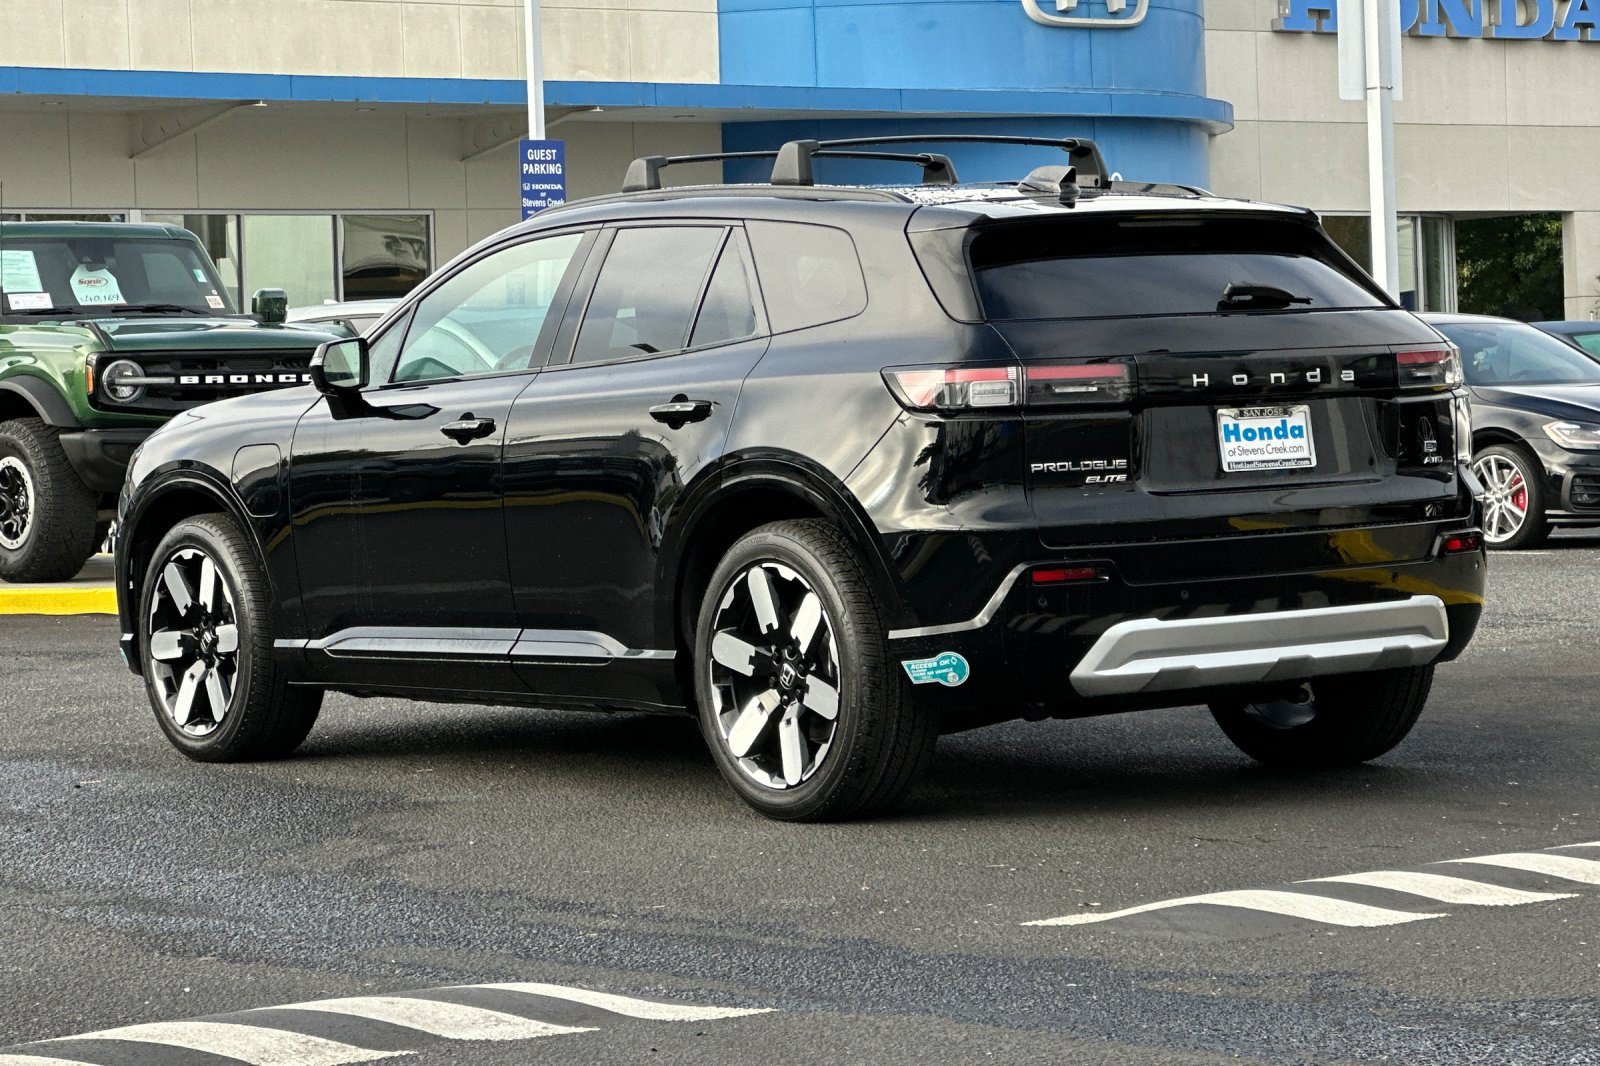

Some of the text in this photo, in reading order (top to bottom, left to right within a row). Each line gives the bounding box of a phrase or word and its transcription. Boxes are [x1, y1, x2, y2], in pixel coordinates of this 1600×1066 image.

[1273, 0, 1600, 41] HNDA
[528, 149, 556, 160] GUEST
[523, 163, 562, 174] PARKING
[522, 198, 547, 207] Stevens
[78, 277, 103, 285] Sonic
[1192, 368, 1355, 387] Honda
[1243, 408, 1284, 417] SAN JOSE
[1223, 419, 1304, 443] Honda
[1228, 442, 1304, 457] of Stevens Creek.com
[1030, 459, 1127, 473] PROLOGUE
[1085, 474, 1128, 484] ELITE
